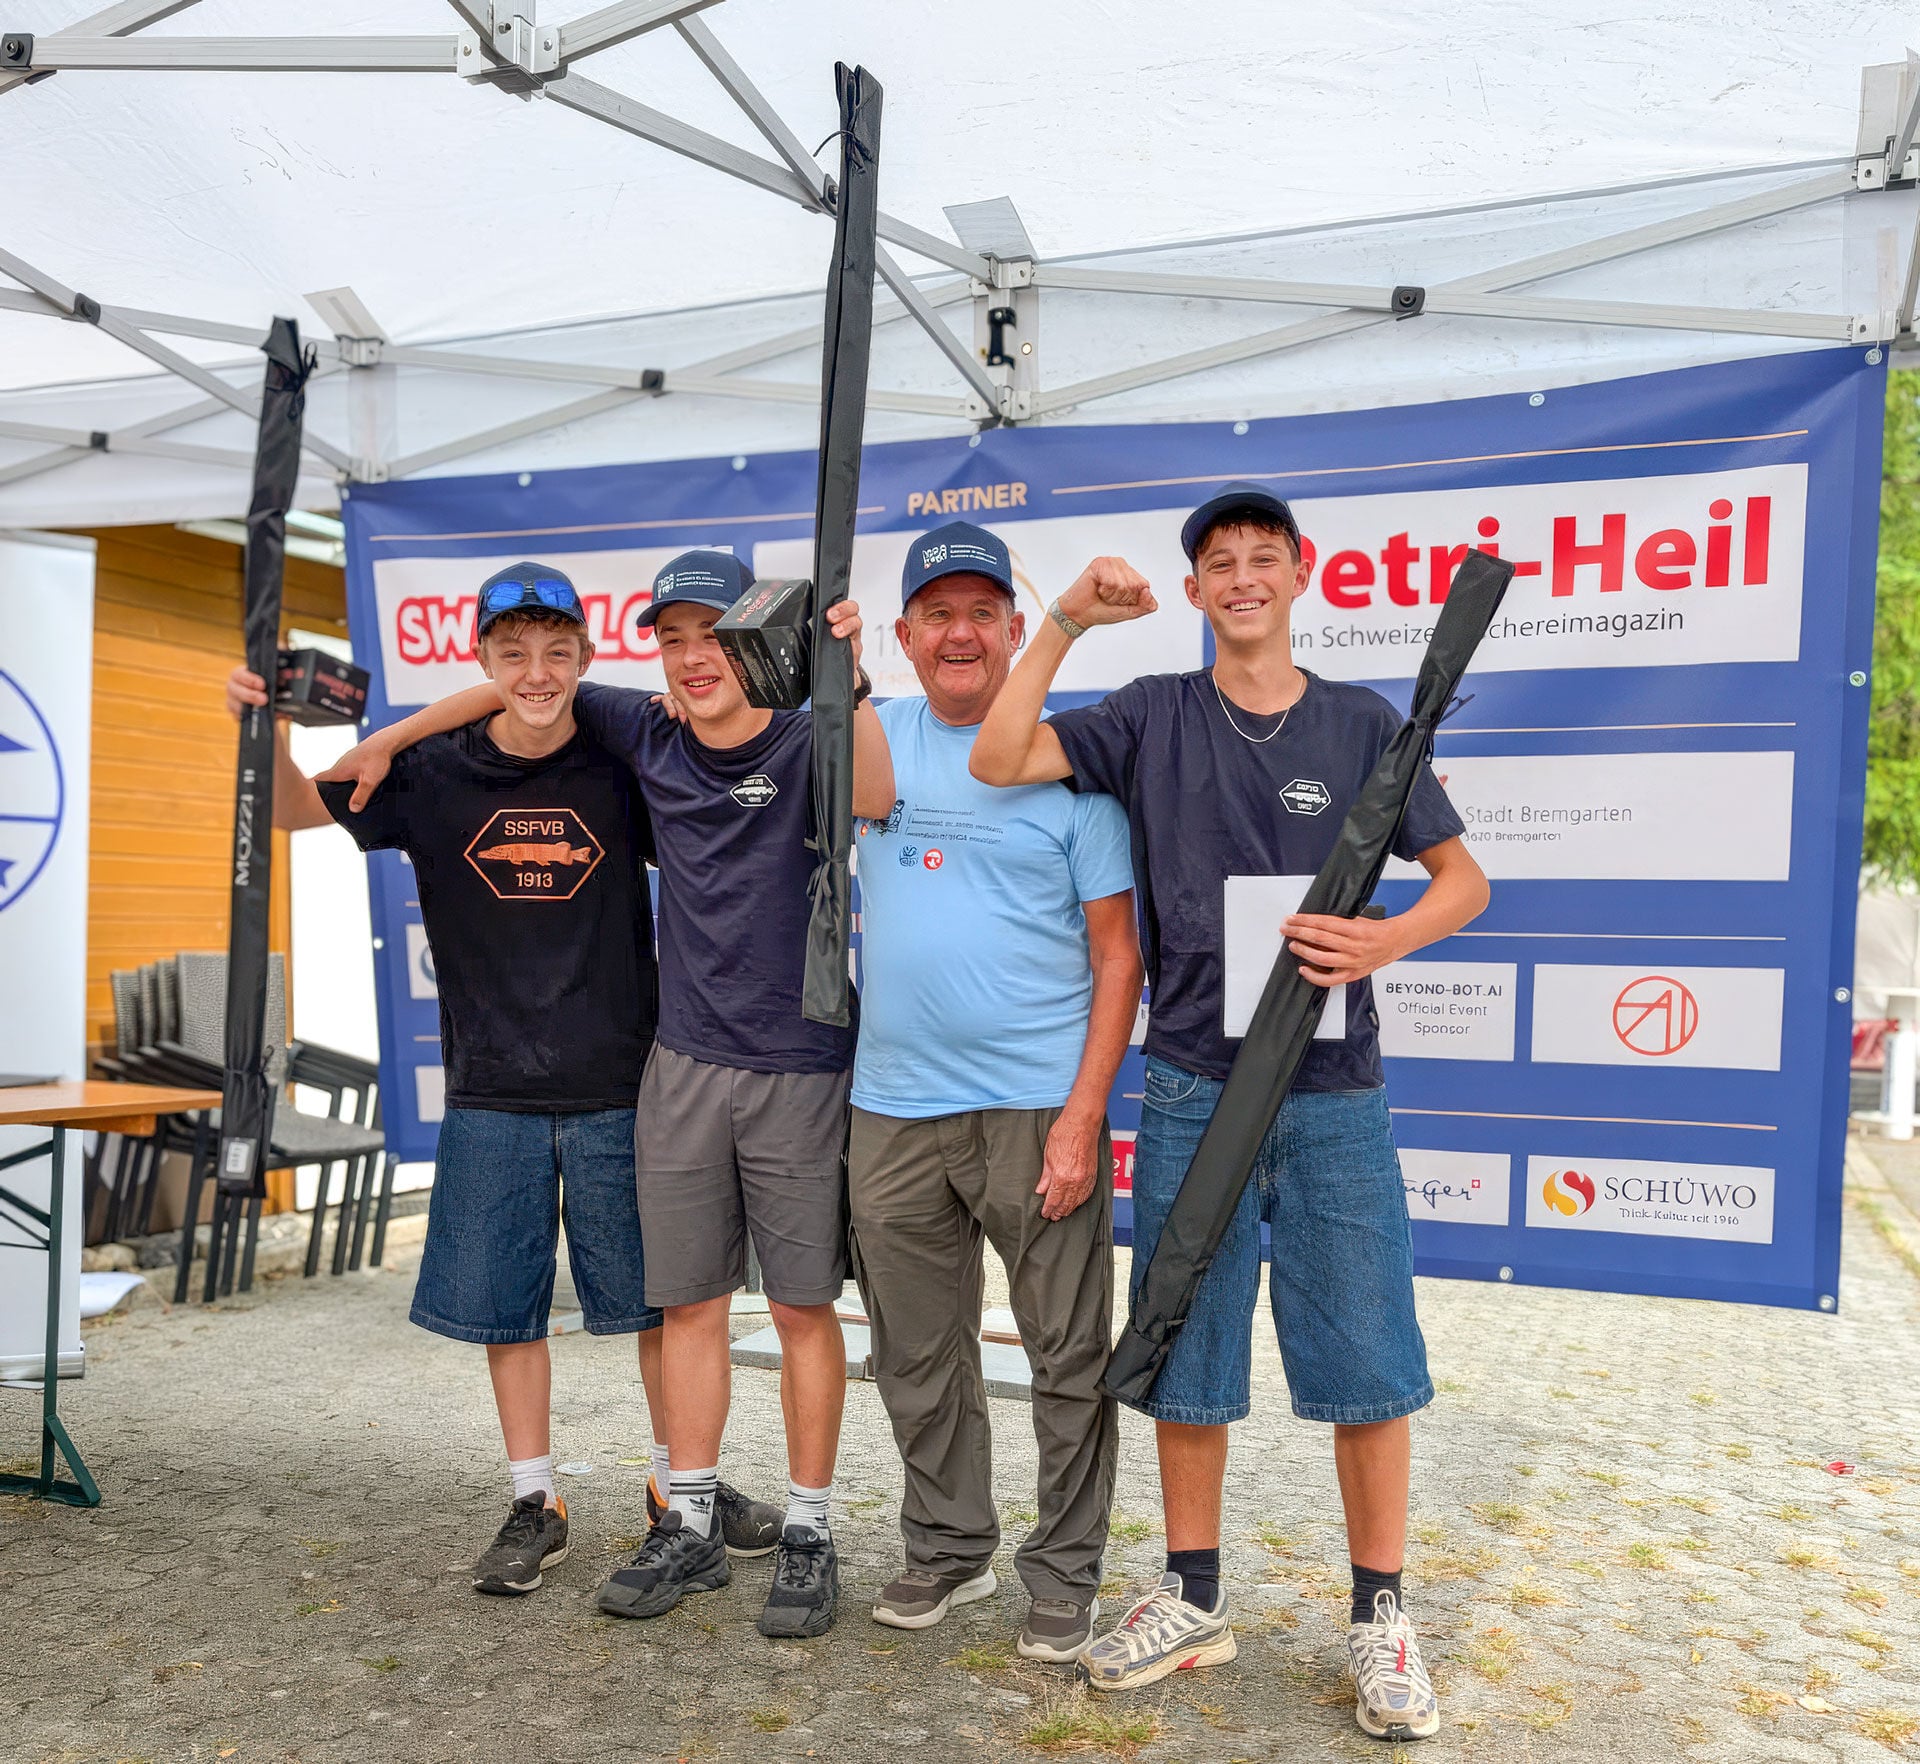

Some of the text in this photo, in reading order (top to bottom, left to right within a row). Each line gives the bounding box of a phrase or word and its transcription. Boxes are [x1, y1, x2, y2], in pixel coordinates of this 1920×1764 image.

[907, 482, 1028, 517] PARTNER
[1291, 628, 1313, 648] in
[1322, 624, 1435, 648] Schweize
[1465, 804, 1632, 826] Stadt Bremgarten
[504, 820, 565, 837] SSFVB
[515, 872, 554, 888] 1913
[1398, 1001, 1488, 1017] Official Event
[1414, 1021, 1471, 1036] Sponsor
[1604, 1176, 1757, 1209] SCHÜWO
